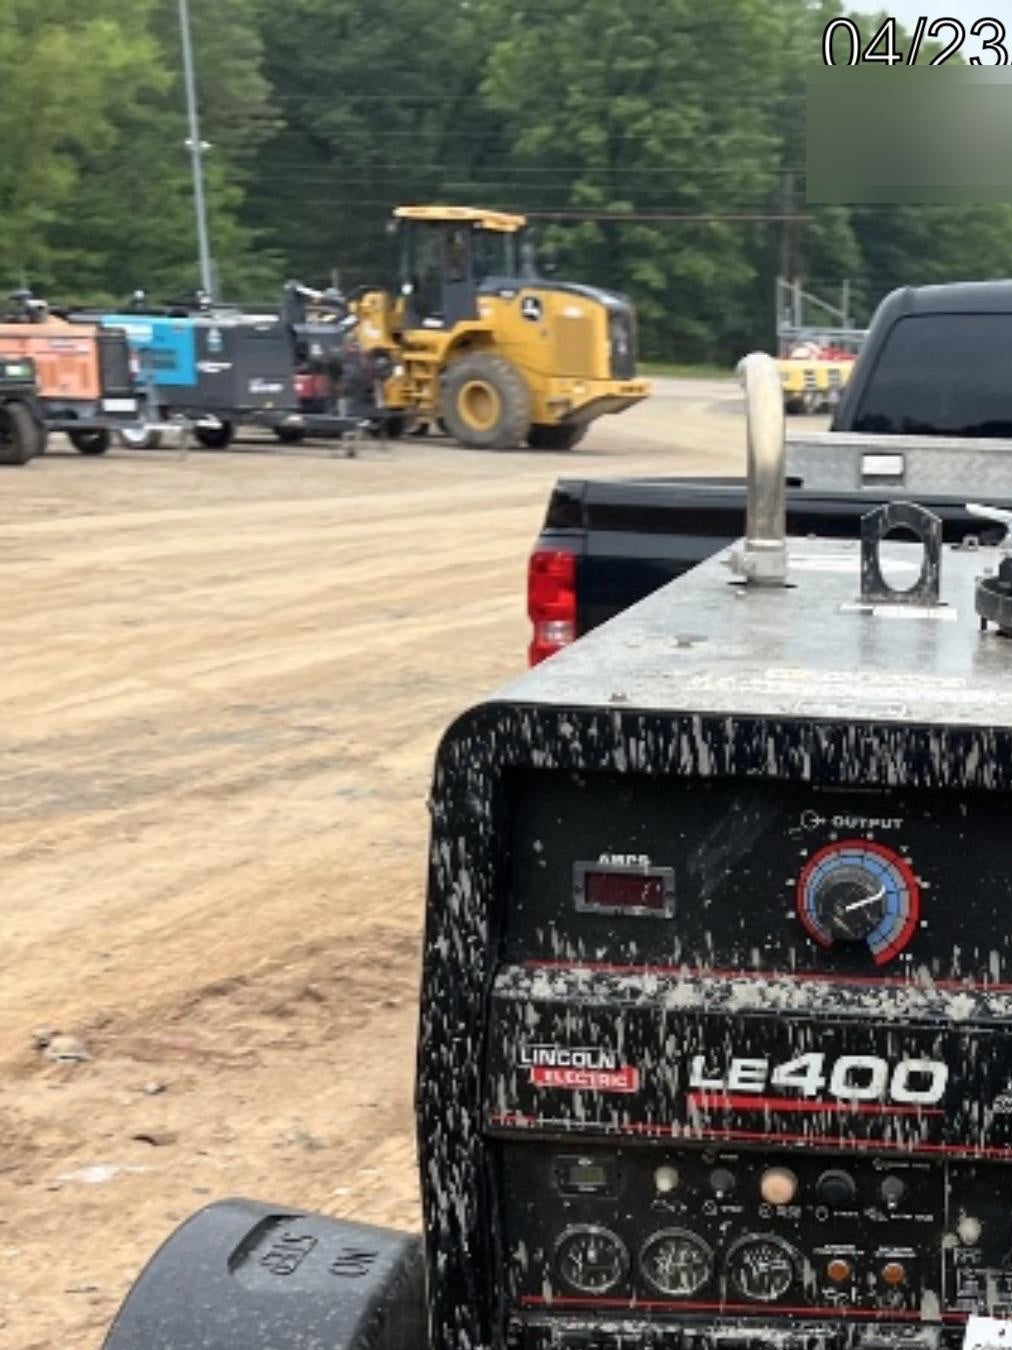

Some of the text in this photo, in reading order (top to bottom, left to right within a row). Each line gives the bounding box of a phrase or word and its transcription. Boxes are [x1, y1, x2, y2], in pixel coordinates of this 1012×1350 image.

[832, 815, 904, 829] OUTPUT
[520, 1046, 616, 1069] LINCOLN
[544, 1070, 628, 1088] ELECTRIC
[688, 1052, 949, 1105] LE400
